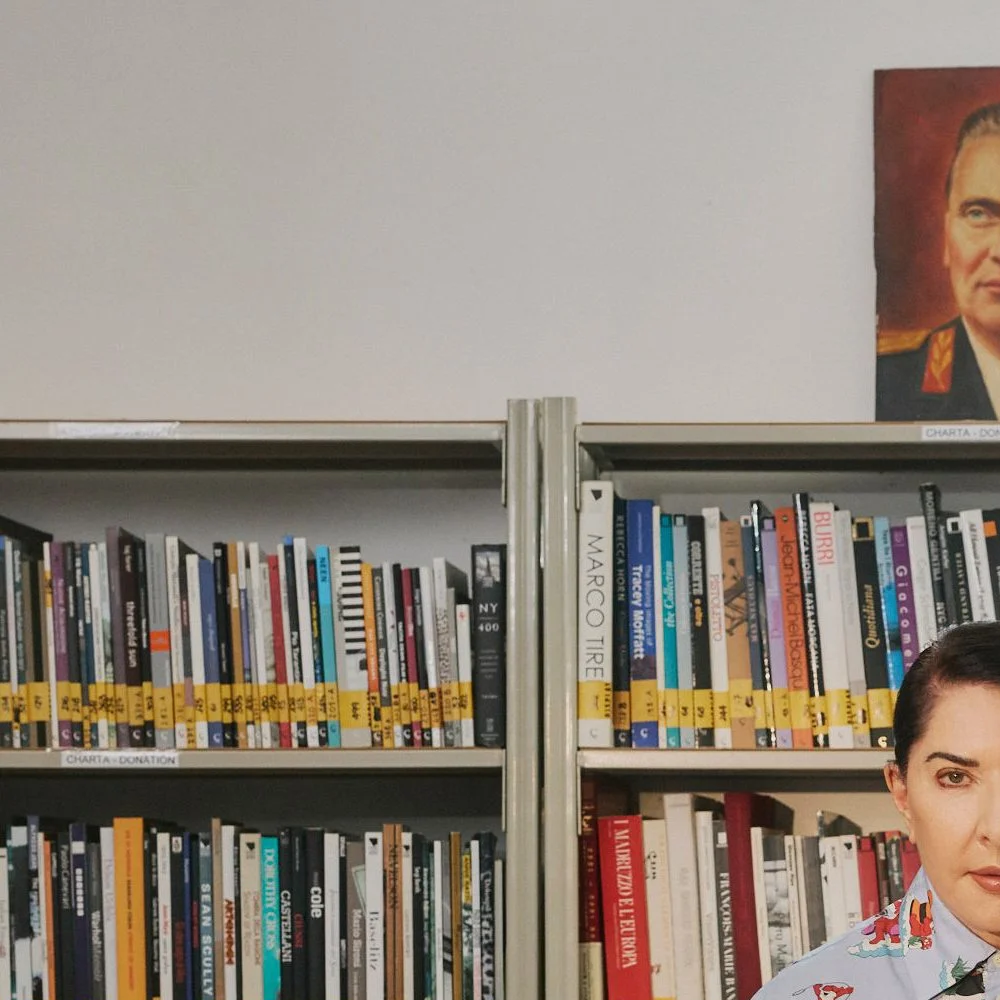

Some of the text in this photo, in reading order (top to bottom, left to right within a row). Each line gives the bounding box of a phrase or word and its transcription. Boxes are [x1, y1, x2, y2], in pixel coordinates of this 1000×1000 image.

[927, 428, 970, 437] CHARTA
[813, 511, 834, 566] BURRI
[925, 491, 936, 537] MORENO
[319, 556, 328, 582] NEEN
[616, 515, 626, 601] REBECCA HORN
[781, 535, 803, 638] Jean-Michel
[479, 603, 498, 614] NY
[585, 534, 605, 679] MARCO TIRE
[630, 564, 645, 660] Tracey Moffatt
[643, 582, 653, 607] Moving
[710, 574, 723, 642] PISTOLETTO
[864, 584, 880, 649] Quotidiana
[126, 601, 138, 668] threefold sun
[478, 623, 500, 633] 400
[67, 755, 176, 765] CHARTA DONATION
[280, 890, 292, 963] CASTELLANI
[310, 886, 324, 919] cole
[351, 909, 362, 938] Mario
[614, 828, 637, 969] MADRUZZO E L'EUROPA
[718, 871, 732, 975] FRANÇOIS-MARIE
[201, 883, 213, 996] SEAN SCULLY
